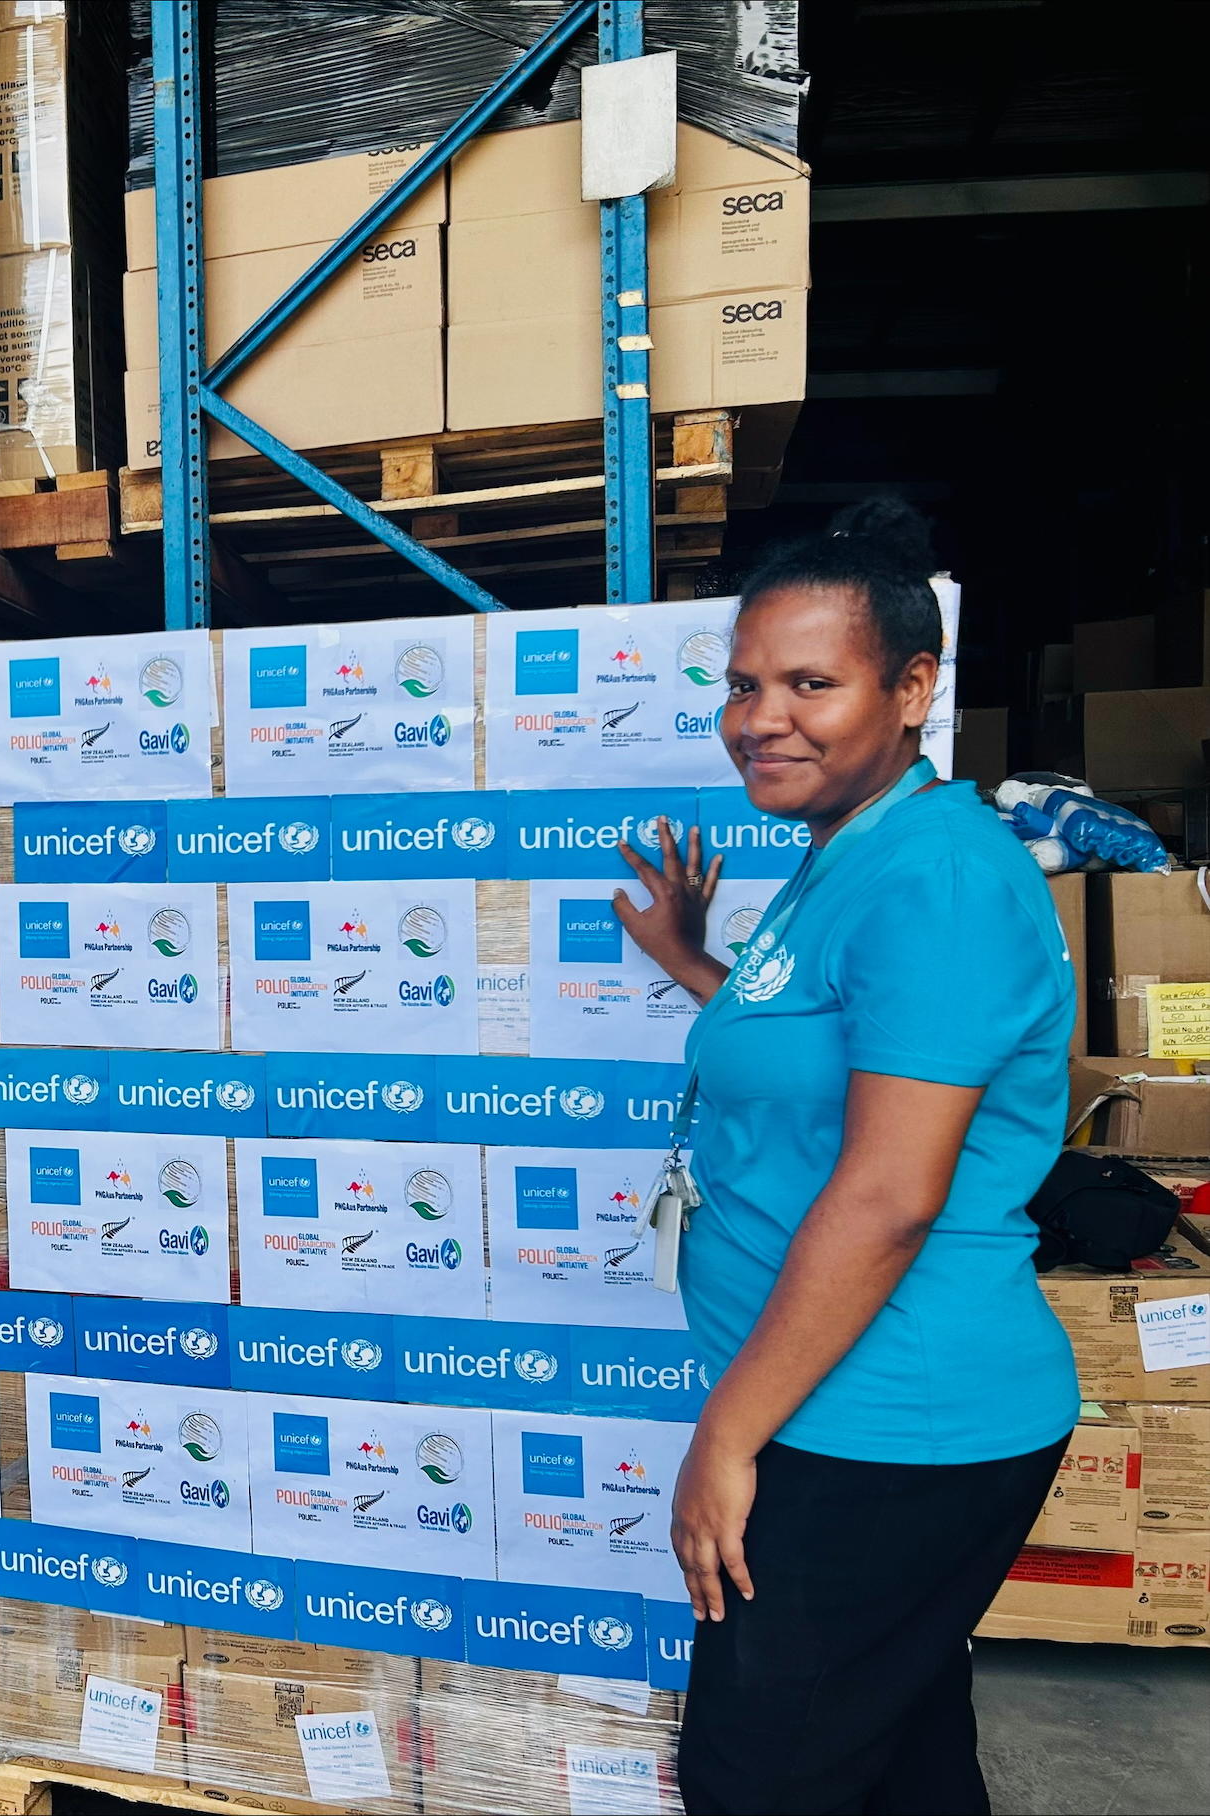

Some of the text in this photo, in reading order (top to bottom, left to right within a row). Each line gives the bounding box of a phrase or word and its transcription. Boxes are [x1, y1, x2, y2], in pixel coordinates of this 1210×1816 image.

[722, 192, 784, 216] seca
[362, 240, 416, 263] seca
[722, 300, 782, 324] seca
[523, 650, 556, 663] unicef
[622, 672, 656, 684] Partnership
[515, 714, 554, 731] POLIO
[554, 710, 578, 718] GLOBAL
[675, 712, 712, 733] Gavi
[554, 725, 586, 734] INITIATIVE
[25, 827, 115, 855] unicef
[178, 824, 274, 853] unicef
[343, 819, 447, 850] unicef
[521, 817, 632, 848] unicef
[712, 820, 811, 847] unice
[25, 921, 52, 930] unicef
[84, 943, 133, 953] PNGAus Partnership
[730, 945, 766, 993] unicef
[21, 976, 52, 990] POLIO
[52, 986, 78, 994] INITIATIVE
[148, 979, 177, 997] Gavi
[399, 981, 432, 1000] Gavi
[477, 974, 525, 993] nicef
[120, 1080, 212, 1107] unicef
[278, 1081, 377, 1109] unicef
[448, 1086, 555, 1115] unicef
[36, 1166, 62, 1176] unicef
[95, 1190, 143, 1202] PNGAus Partnership
[31, 1221, 62, 1236] POLIO
[159, 1229, 188, 1250] Gavi
[1140, 1304, 1187, 1324] unicef
[86, 1326, 176, 1354] unicef
[240, 1336, 337, 1366] unicef
[406, 1347, 510, 1377] unicef
[583, 1358, 693, 1389] unicef
[530, 1454, 562, 1466] unicef
[602, 1483, 661, 1496] PNGAus Partnership
[417, 1505, 450, 1527] Gavi
[524, 1512, 562, 1530] POLIO
[562, 1513, 586, 1522] GLOBAL
[562, 1528, 594, 1536] INITIATIVE
[2, 1549, 88, 1580] unicef
[149, 1571, 241, 1603] unicef
[307, 1593, 406, 1624] unicef
[478, 1612, 583, 1644] unicef
[89, 1689, 138, 1711] unicef
[302, 1721, 352, 1741] unicef
[571, 1756, 628, 1775] unicef
